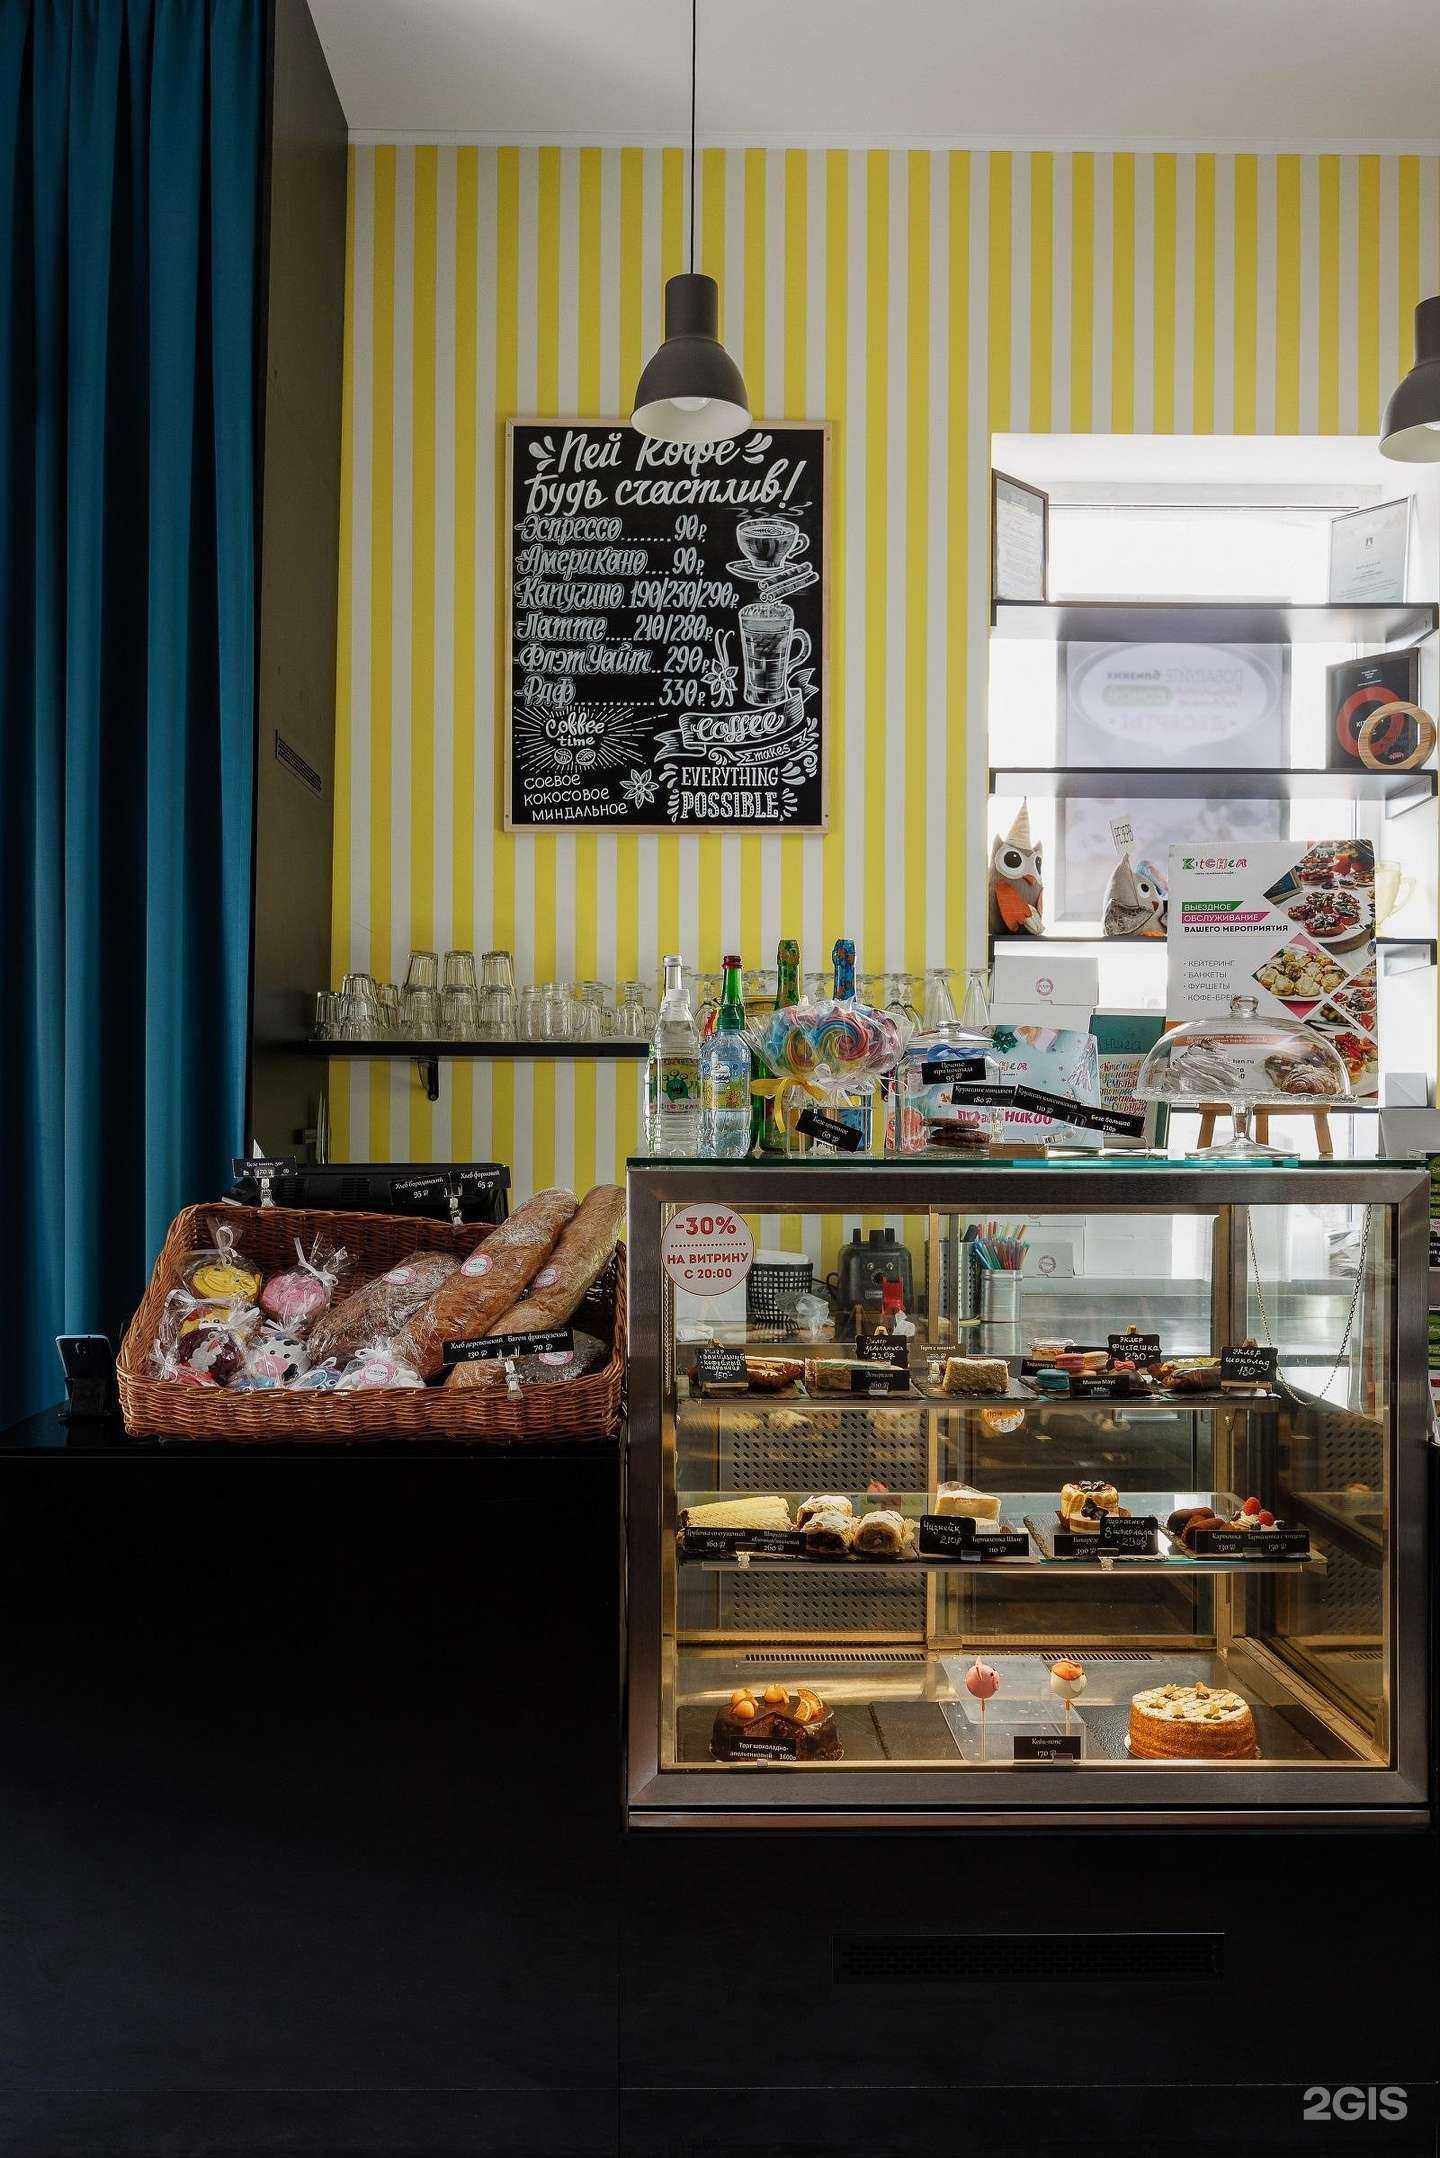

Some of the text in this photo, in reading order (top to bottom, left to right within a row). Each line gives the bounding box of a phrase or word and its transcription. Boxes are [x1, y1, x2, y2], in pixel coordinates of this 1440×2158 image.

[557, 430, 622, 473] Пей
[615, 459, 808, 509] счастлив!
[515, 514, 623, 545] Эспрессо
[515, 543, 648, 581] Американо
[514, 576, 625, 613] Капучино
[515, 610, 607, 642] Латте
[545, 711, 605, 738] Coffee
[557, 736, 595, 747] time
[681, 767, 778, 787] EVERYTHING
[680, 791, 779, 819] POSSIBLE
[1184, 903, 1232, 911] ВЫЕЗДНОЕ
[1184, 913, 1259, 922] ОБСЛУЖИВАНИЕ
[675, 1216, 737, 1235] -30%
[667, 1252, 749, 1264] НА ВИТРИНУ
[684, 1268, 732, 1279] С 20:00
